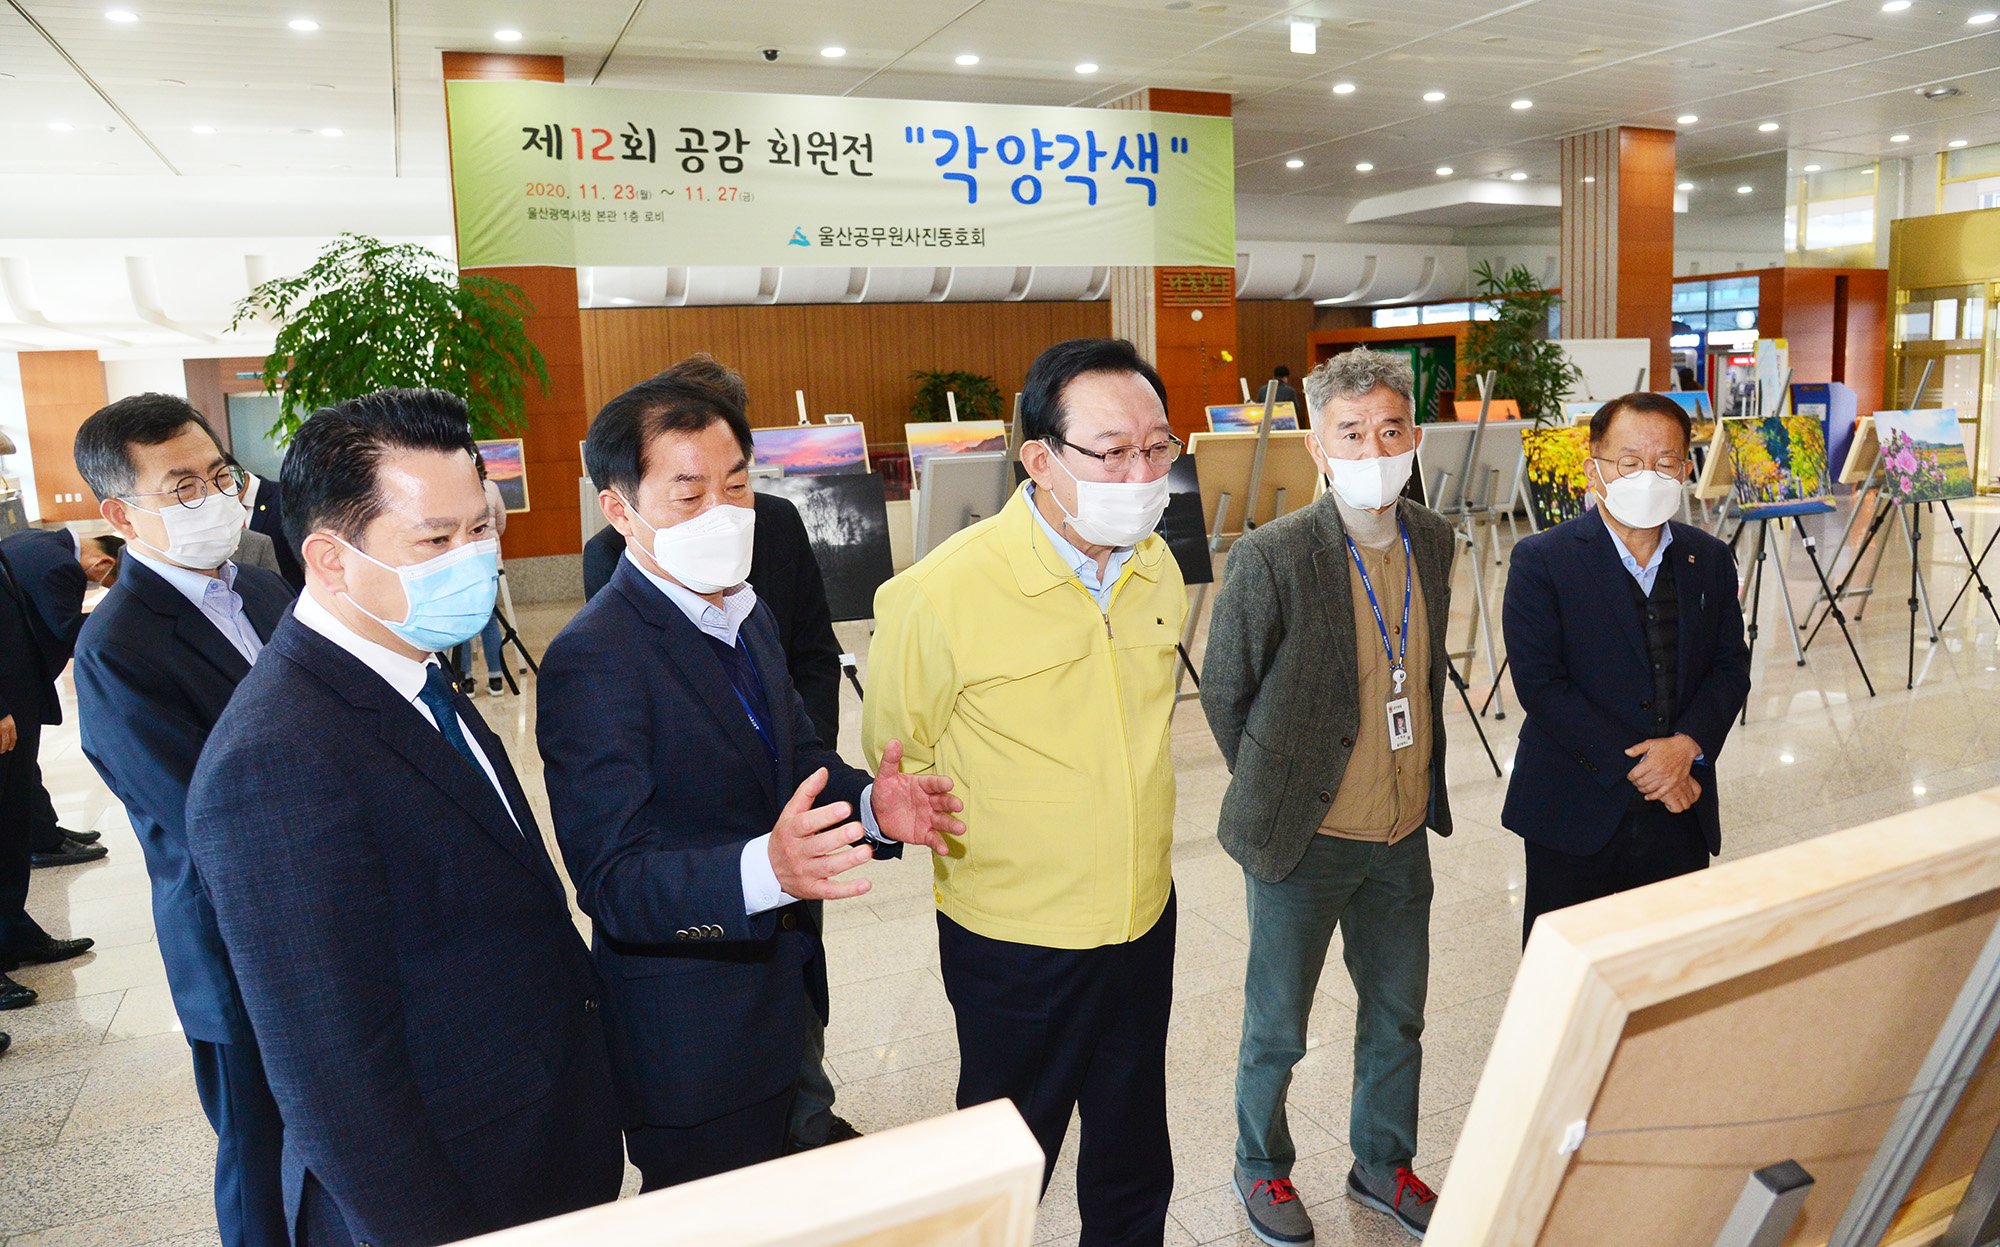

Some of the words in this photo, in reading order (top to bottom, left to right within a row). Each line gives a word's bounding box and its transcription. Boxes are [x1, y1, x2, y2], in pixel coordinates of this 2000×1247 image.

[521, 122, 657, 164] 제12회
[674, 127, 751, 174] 공감
[767, 127, 874, 177] 회원전
[525, 182, 571, 199] 2020.
[578, 183, 606, 200] 11.
[685, 186, 711, 202] 11.
[526, 206, 592, 223] 울산광역시청
[596, 209, 617, 223] 본관
[623, 210, 639, 224] 1층
[644, 211, 665, 223] 로비
[817, 225, 986, 248] 울산공무원사진동호회
